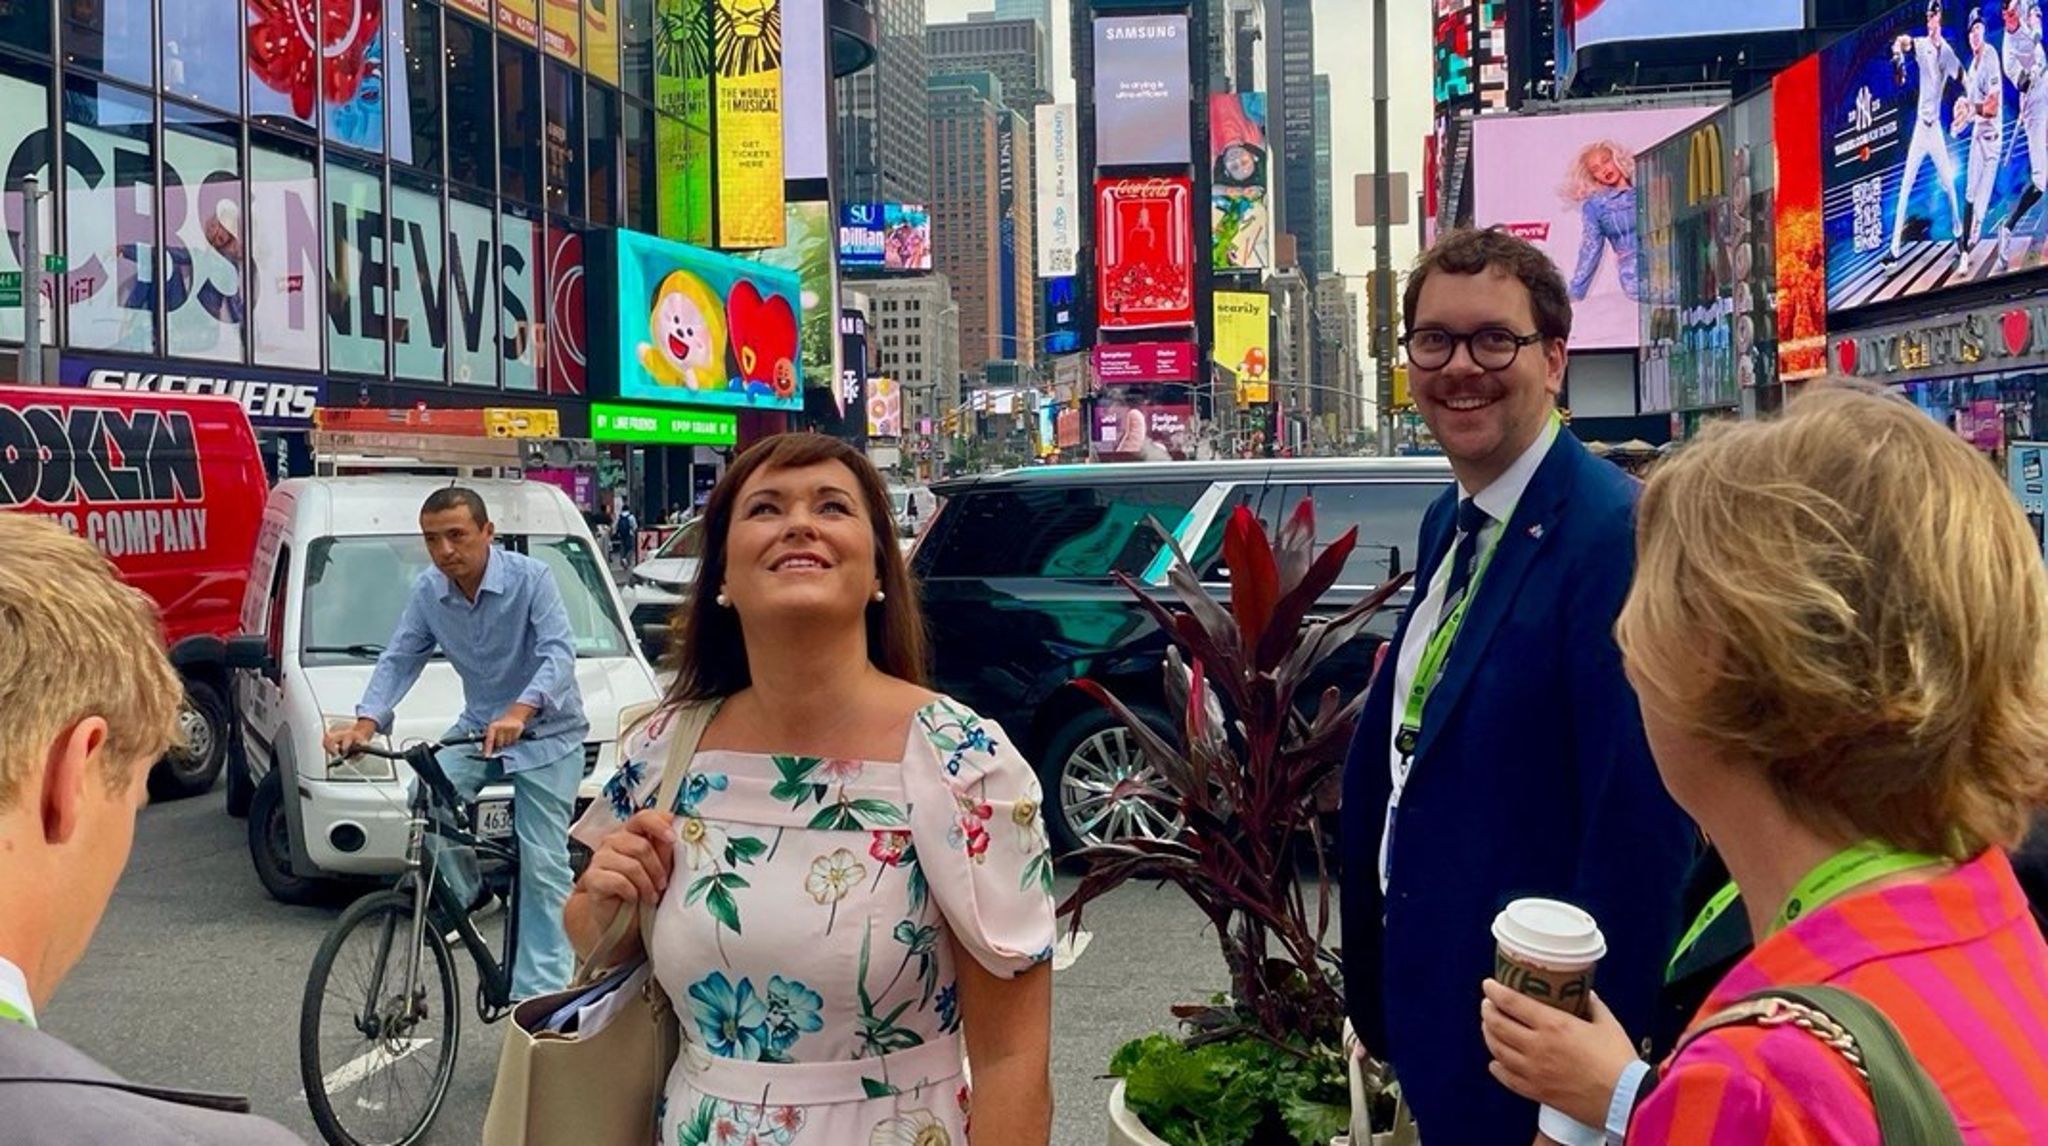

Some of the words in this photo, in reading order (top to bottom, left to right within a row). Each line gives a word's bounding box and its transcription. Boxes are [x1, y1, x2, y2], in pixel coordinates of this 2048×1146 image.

[1106, 26, 1176, 40] SAMSUNG
[720, 88, 737, 98] THE
[739, 88, 777, 99] WORLD'S
[733, 99, 778, 114] MUSICAL
[742, 141, 760, 149] GET
[732, 150, 771, 159] TICKETS
[840, 227, 885, 247] Dillian
[4, 129, 259, 324] CBS
[284, 189, 527, 361] NEWS
[1217, 302, 1261, 316] scarily
[1151, 412, 1179, 423] Swipe
[0, 404, 205, 507] OOKLYN
[86, 508, 207, 557] COMPANY
